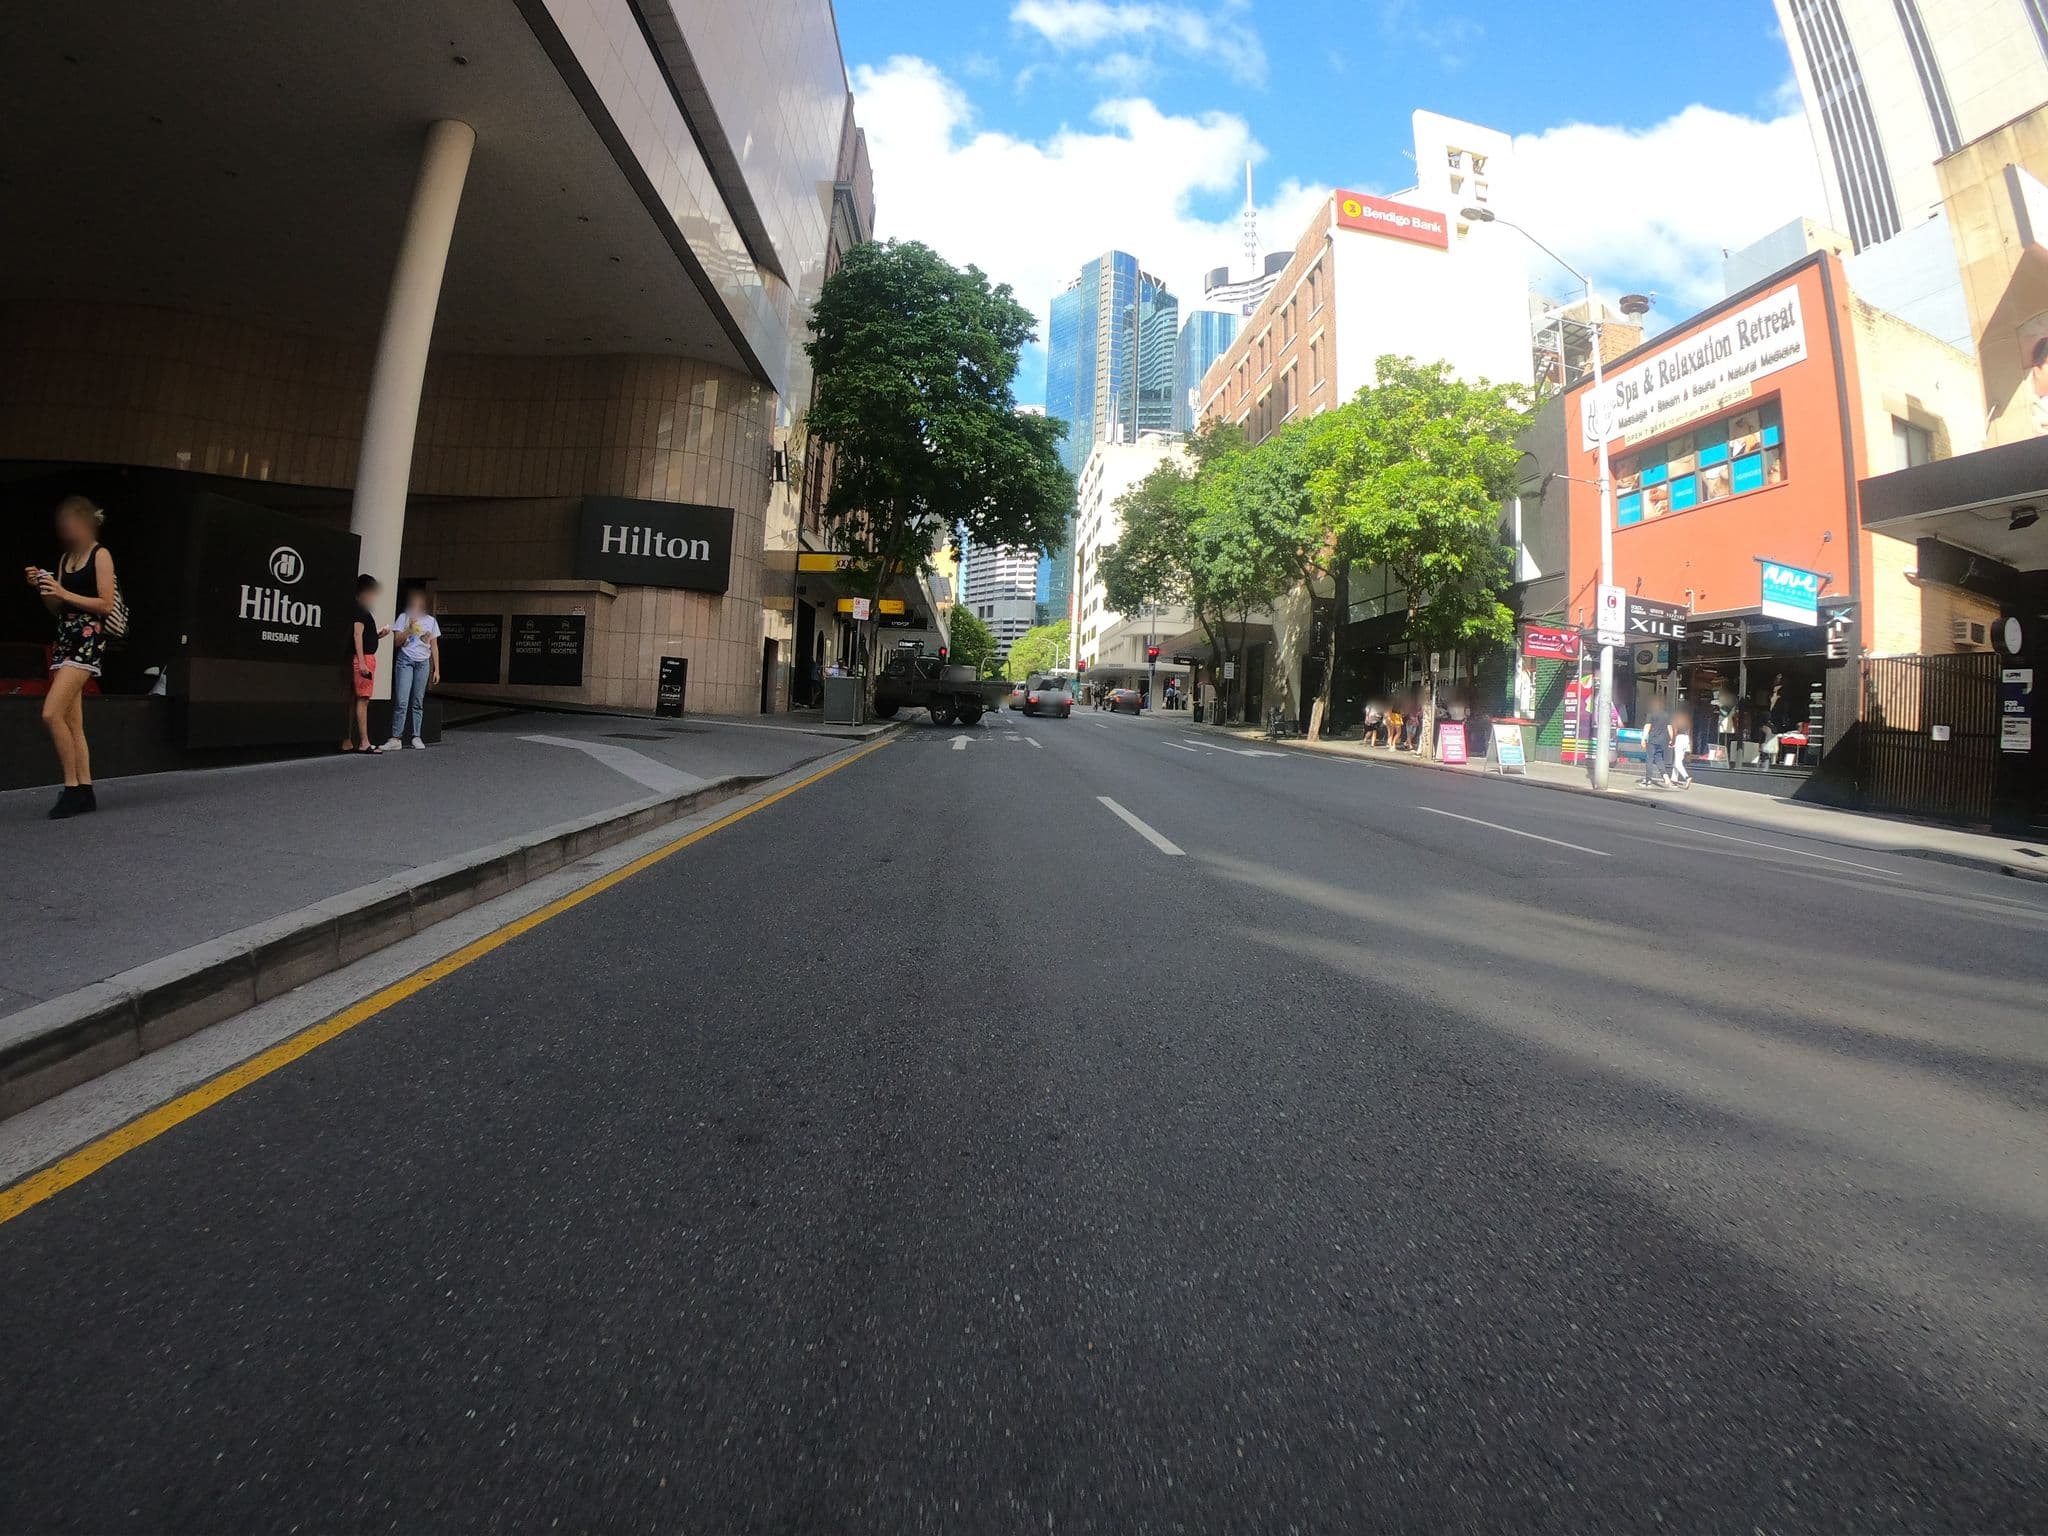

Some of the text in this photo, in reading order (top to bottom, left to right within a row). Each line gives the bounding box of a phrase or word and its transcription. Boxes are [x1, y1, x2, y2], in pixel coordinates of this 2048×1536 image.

[1362, 206, 1442, 233] Bendigo Bank
[1616, 381, 1639, 410] Spa
[1643, 367, 1654, 395] &
[1658, 334, 1733, 388] Relaxation
[1737, 301, 1796, 351] Retreat
[1618, 409, 1648, 428] Massage
[1692, 380, 1716, 397] Sauna
[1727, 360, 1757, 381] Natural
[1760, 342, 1801, 366] Medicine
[1626, 431, 1643, 442] OPEN
[601, 524, 710, 561] Hilton
[239, 584, 321, 628] Hilton
[262, 631, 300, 643] BRISBANE
[1630, 618, 1685, 638] XILE
[1825, 607, 1854, 659] XILE
